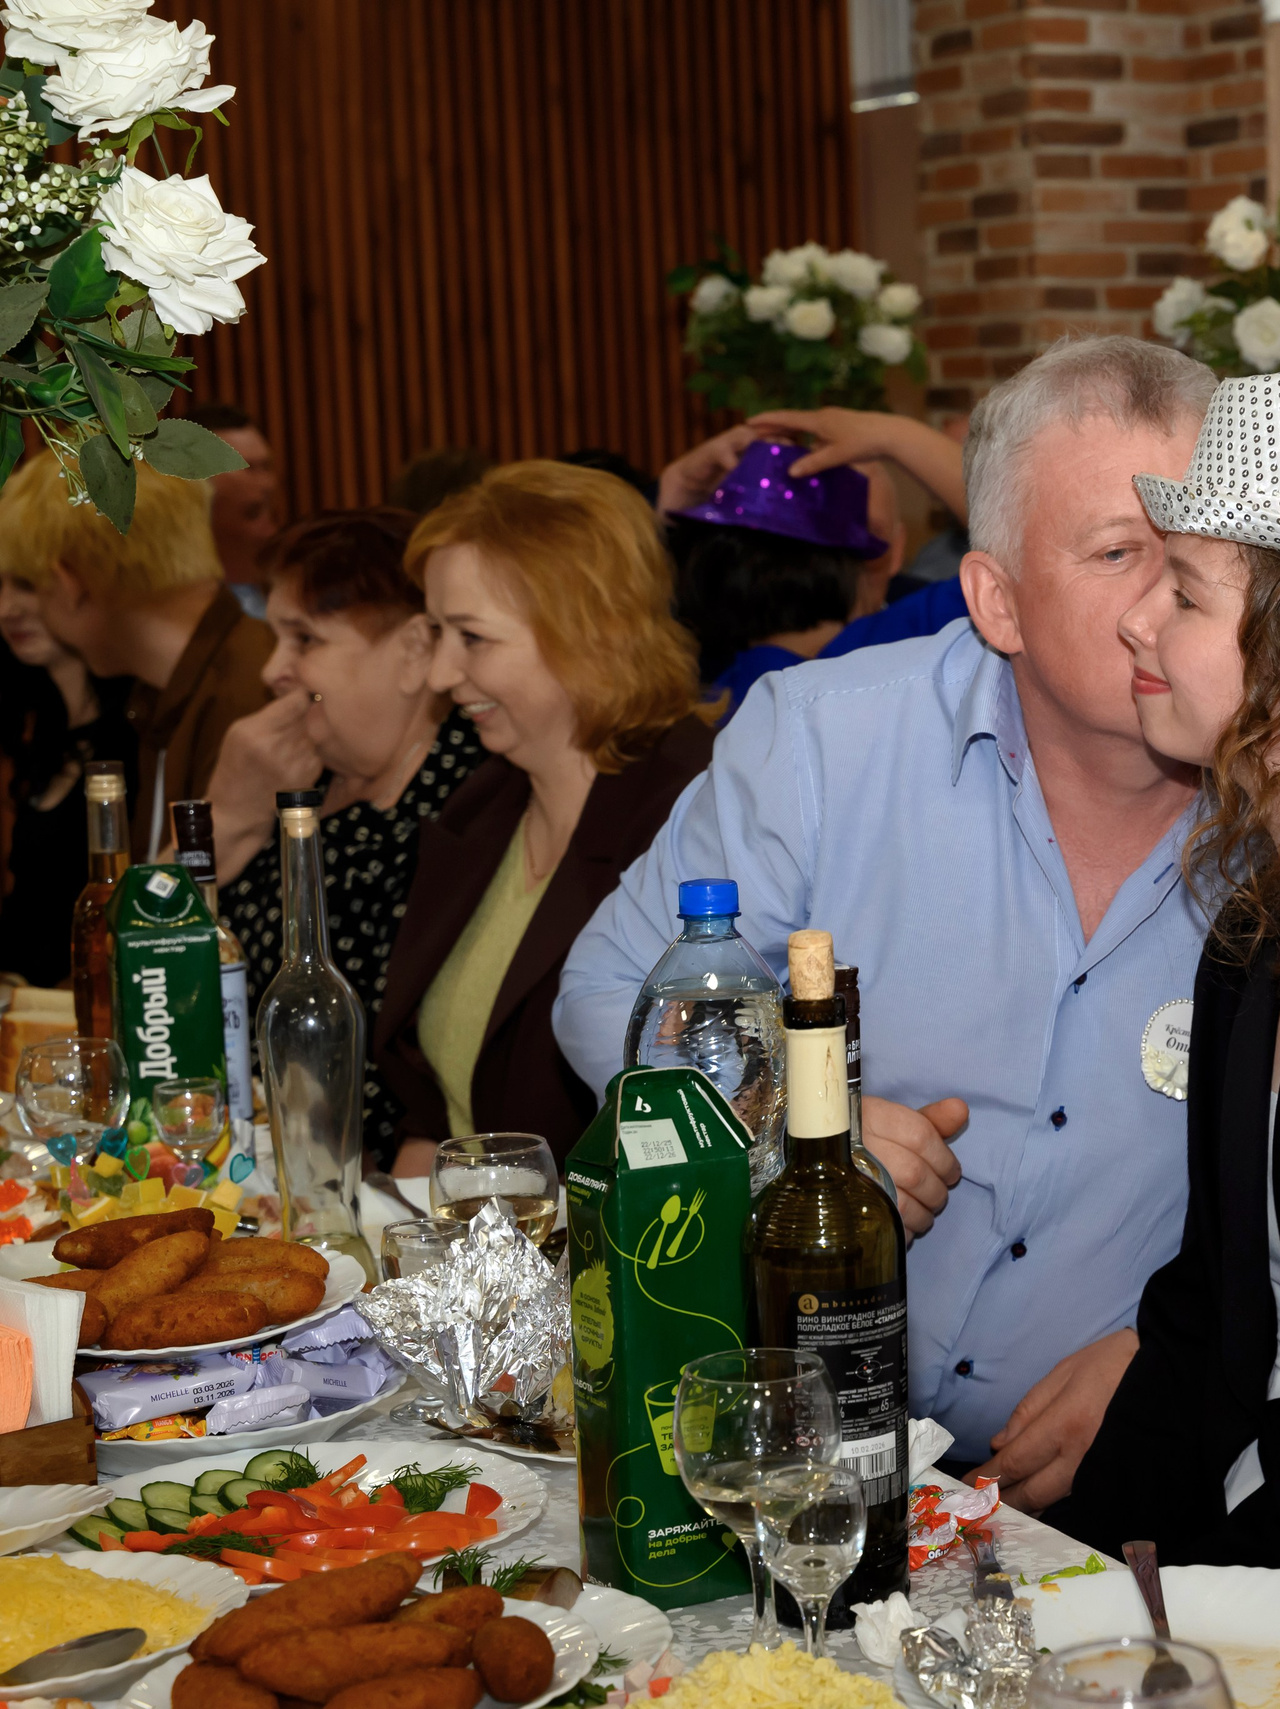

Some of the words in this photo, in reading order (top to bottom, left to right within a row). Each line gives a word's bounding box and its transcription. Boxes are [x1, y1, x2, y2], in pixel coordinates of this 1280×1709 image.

[132, 966, 179, 1080] Добрый
[797, 1315, 819, 1324] ВИНО
[821, 1311, 876, 1323] ВИНОГРАДНОЕ
[797, 1323, 850, 1332] ПОЛУСЛАДКОЕ
[851, 1319, 874, 1330] БЕЛОЕ
[323, 1377, 348, 1388] MICHELLE
[150, 1387, 190, 1402] MICHELLE
[193, 1388, 236, 1404] 03.11.2026
[880, 1398, 890, 1412] 65
[851, 1442, 885, 1455] 10.02.2026
[648, 1539, 662, 1549] на
[665, 1531, 707, 1547] добрые
[648, 1548, 676, 1560] дела
